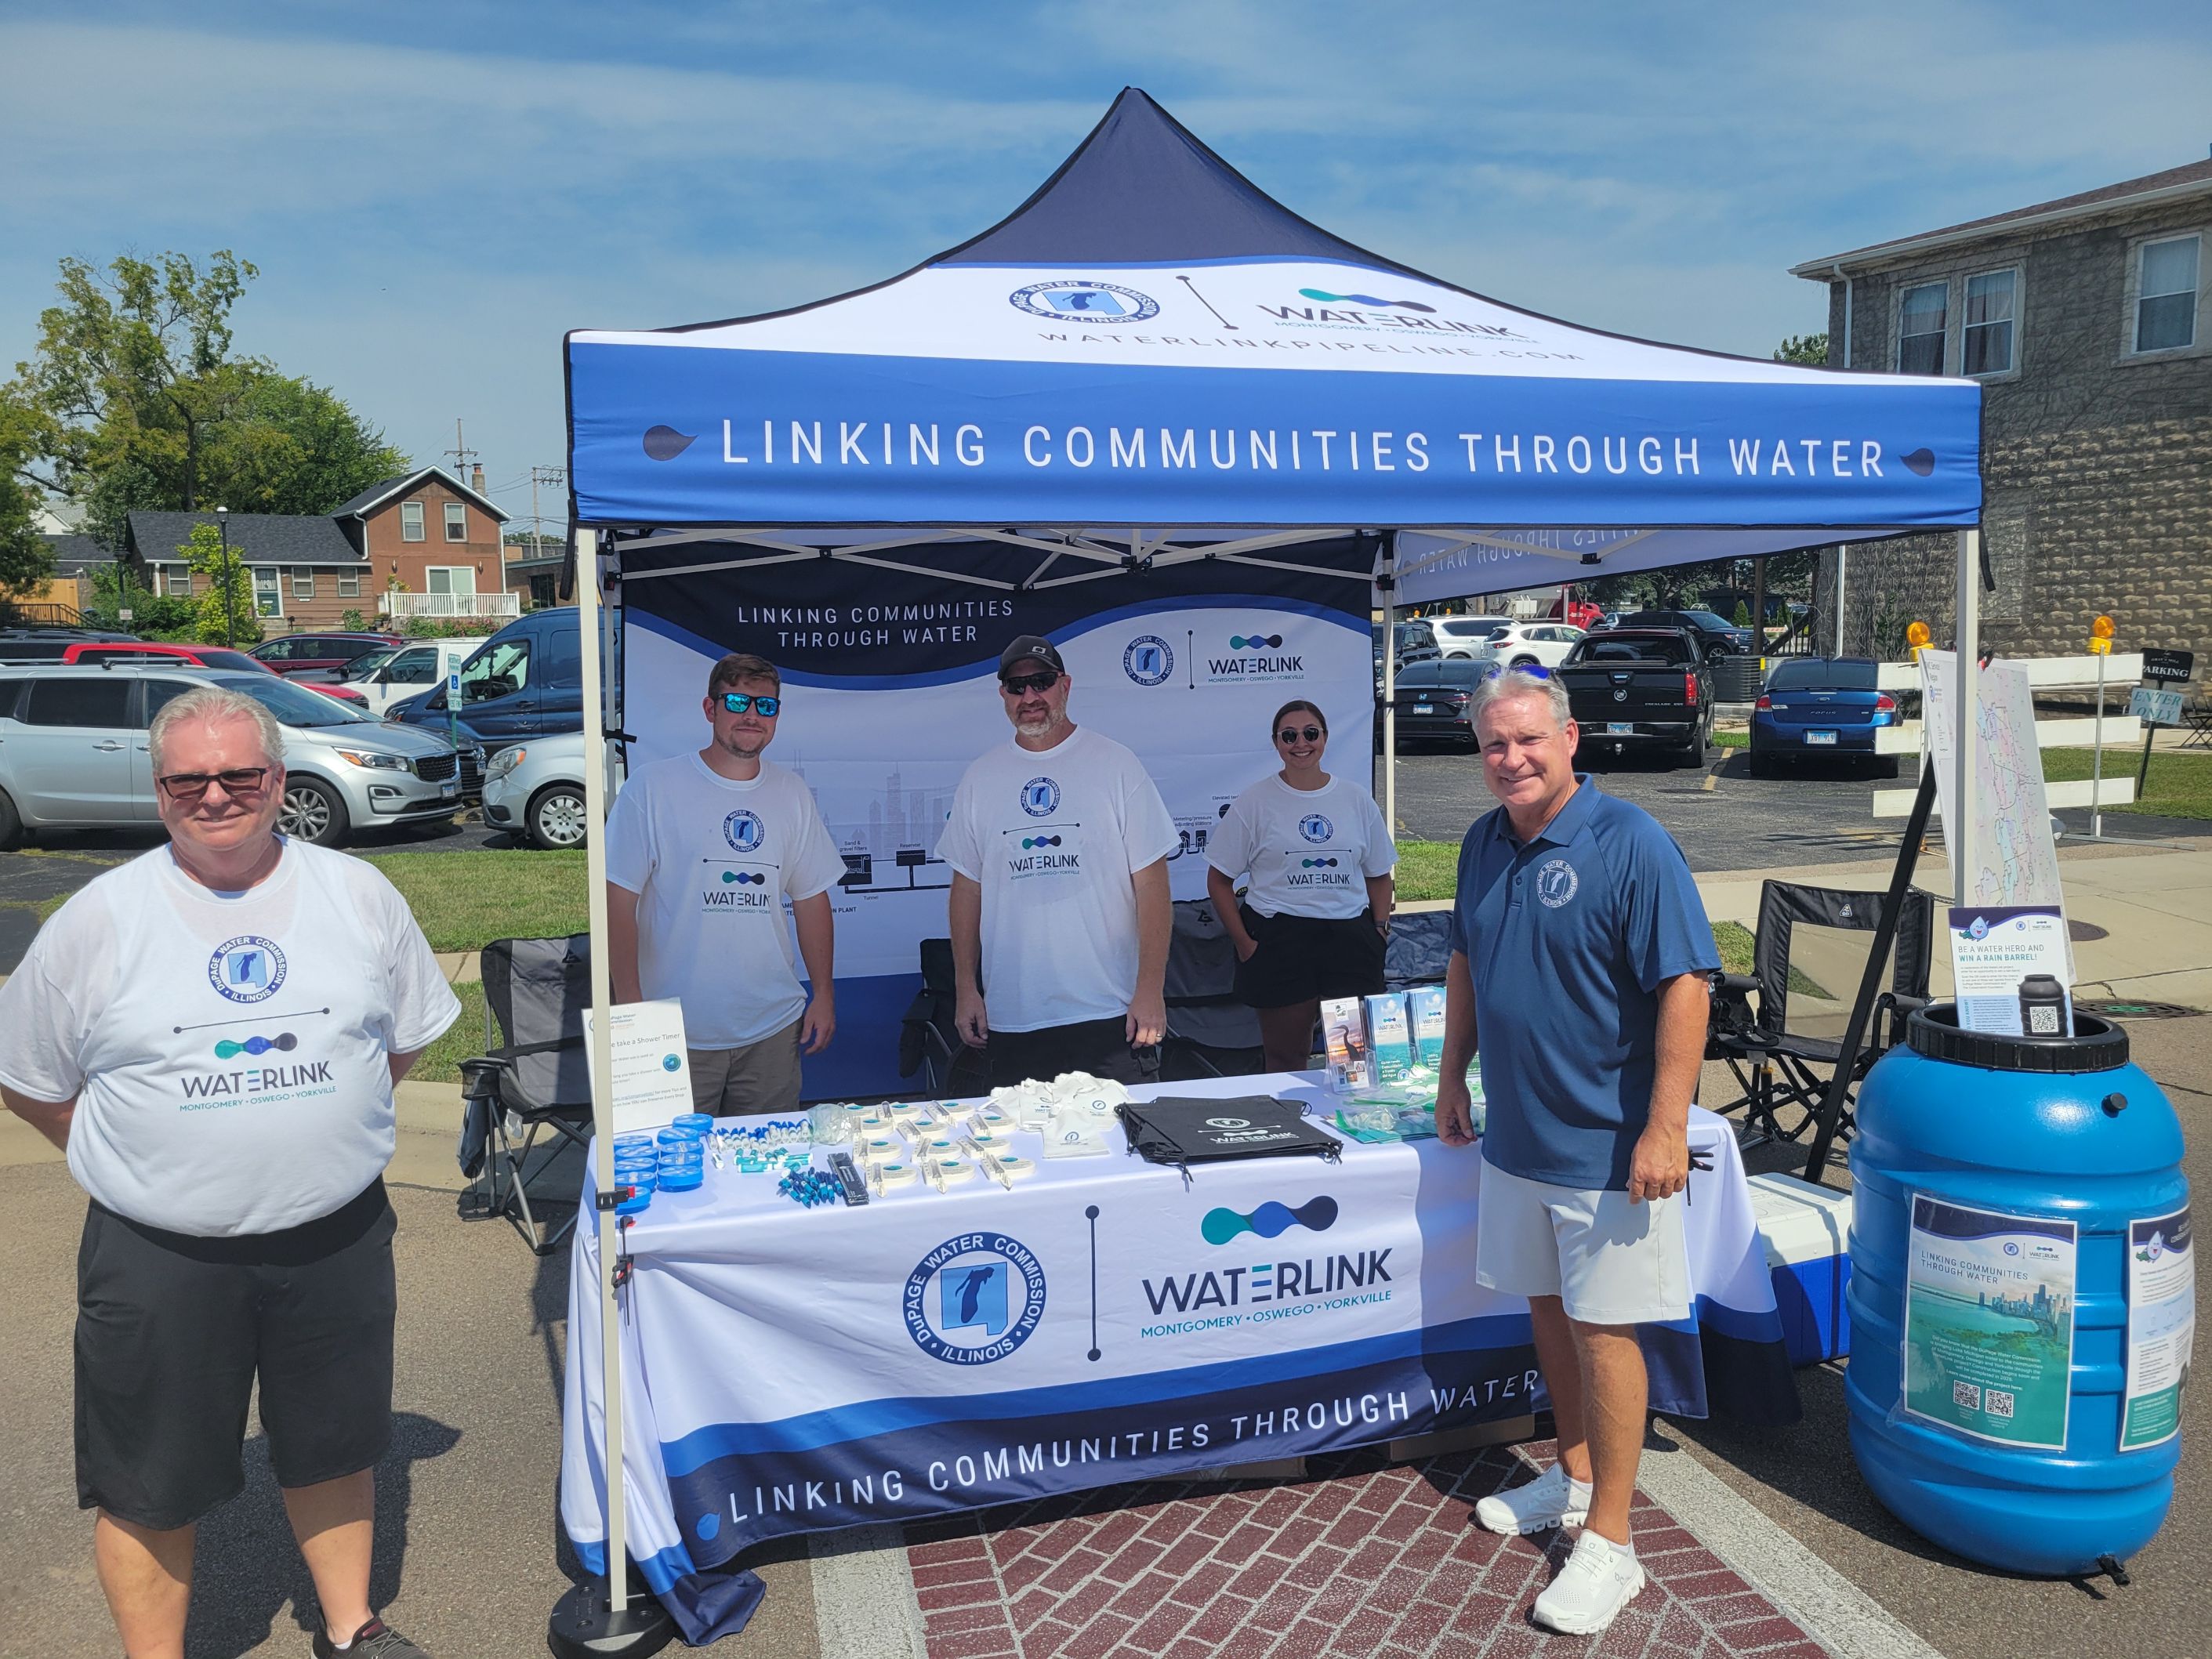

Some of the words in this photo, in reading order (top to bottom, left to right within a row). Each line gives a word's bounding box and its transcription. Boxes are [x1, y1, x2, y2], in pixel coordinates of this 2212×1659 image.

[1024, 281, 1080, 292] WATER
[1090, 281, 1156, 317] COMMISSION
[1061, 313, 1139, 324] ILLINOIS
[1256, 304, 1528, 339] WATERLINK
[1275, 321, 1380, 332] MONTGOMERY
[1390, 328, 1459, 337] OSWEGO
[1038, 333, 1586, 360] WATERLINKPIPELINE.COM
[723, 418, 986, 466] LINKING
[1023, 426, 1431, 472] COMMUNITIES
[1458, 433, 1700, 475] THROUGH
[1728, 438, 1884, 477] WATER
[738, 606, 838, 624] LINKING
[851, 599, 1013, 623] COMMUNITIES
[778, 629, 889, 647] THROUGH
[902, 626, 977, 644] WATER
[1130, 636, 1152, 647] WATER
[1155, 638, 1173, 676] COMMISSION
[1208, 656, 1304, 675] WATERLINK
[1137, 676, 1163, 686] ILLINOIS
[2134, 691, 2181, 707] ENTER
[2138, 707, 2176, 720] ONLY
[1027, 777, 1043, 788] WATER
[729, 810, 747, 819] WATER
[749, 813, 764, 844] COMMISSION
[732, 843, 756, 852] ILLINOIS
[1008, 854, 1079, 873] WATERLINK
[1545, 861, 1564, 870] WATER
[1287, 873, 1350, 885] WATERLINK
[703, 891, 771, 907] WATERLIN
[218, 936, 250, 954] WATER
[256, 938, 286, 984] COMMISSION
[230, 988, 272, 1002] ILLINOIS
[637, 1035, 661, 1044] Shower
[181, 1060, 334, 1099] WATERLINK
[179, 1099, 244, 1111] MONTGOMERY
[250, 1093, 290, 1104] OSWEGO
[296, 1085, 337, 1098] YORKVILLE
[1210, 1132, 1296, 1143] WATERLINK
[1921, 1250, 1956, 1266] LINKING
[1960, 1260, 2029, 1280] COMMUNITIES
[1921, 1259, 1963, 1277] THROUGH
[1966, 1271, 1998, 1284] WATER
[905, 1272, 929, 1345] DuPAGE
[923, 1233, 985, 1270] WATER
[994, 1237, 1045, 1330] COMMISSION
[1142, 1248, 1393, 1316] WATERLINK
[1140, 1314, 1243, 1338] MONTGOMERY
[1253, 1303, 1315, 1324] OSWEGO
[1323, 1289, 1392, 1311] YORKVILLE
[941, 1337, 1016, 1363] ILLINOIS
[1964, 1349, 1984, 1359] Michigan
[1978, 1347, 1996, 1356] DuPage
[2012, 1354, 2041, 1363] Commission
[1946, 1368, 1959, 1377] Learn
[1994, 1381, 2010, 1389] project
[730, 1469, 904, 1523] LINKING
[929, 1423, 1209, 1491] COMMUNITIES
[1231, 1391, 1409, 1440] THROUGH
[1430, 1369, 1539, 1414] WATER
